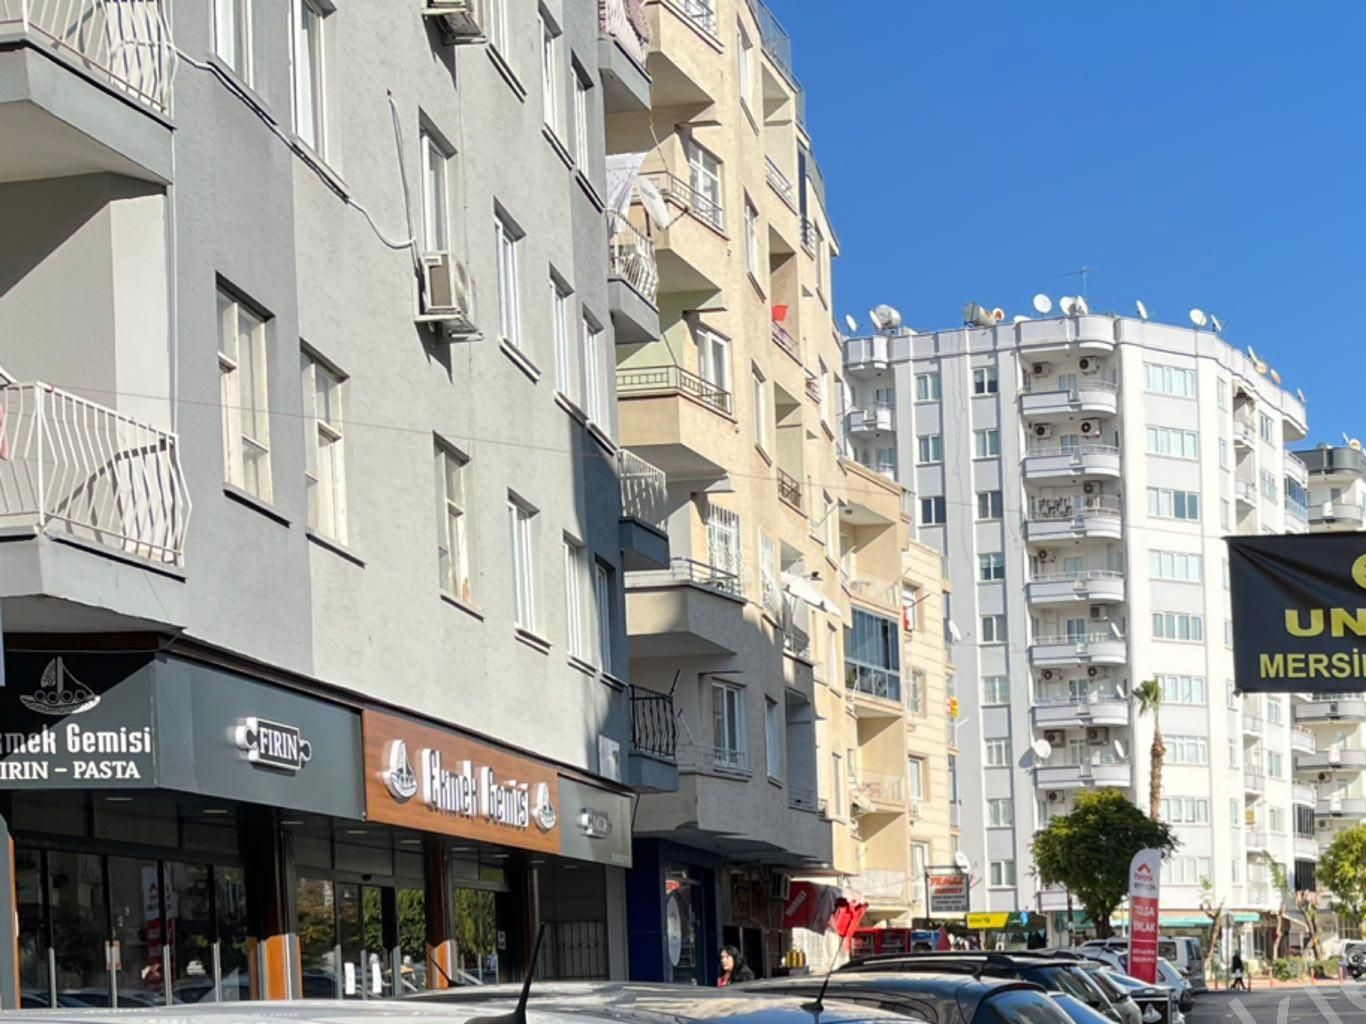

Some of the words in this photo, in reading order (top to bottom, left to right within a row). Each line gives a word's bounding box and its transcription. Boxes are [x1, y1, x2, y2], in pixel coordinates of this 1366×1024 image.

[0, 724, 56, 754] mek
[66, 723, 150, 753] Gemisi
[259, 727, 298, 761] FIRIN
[73, 761, 141, 779] PASTA
